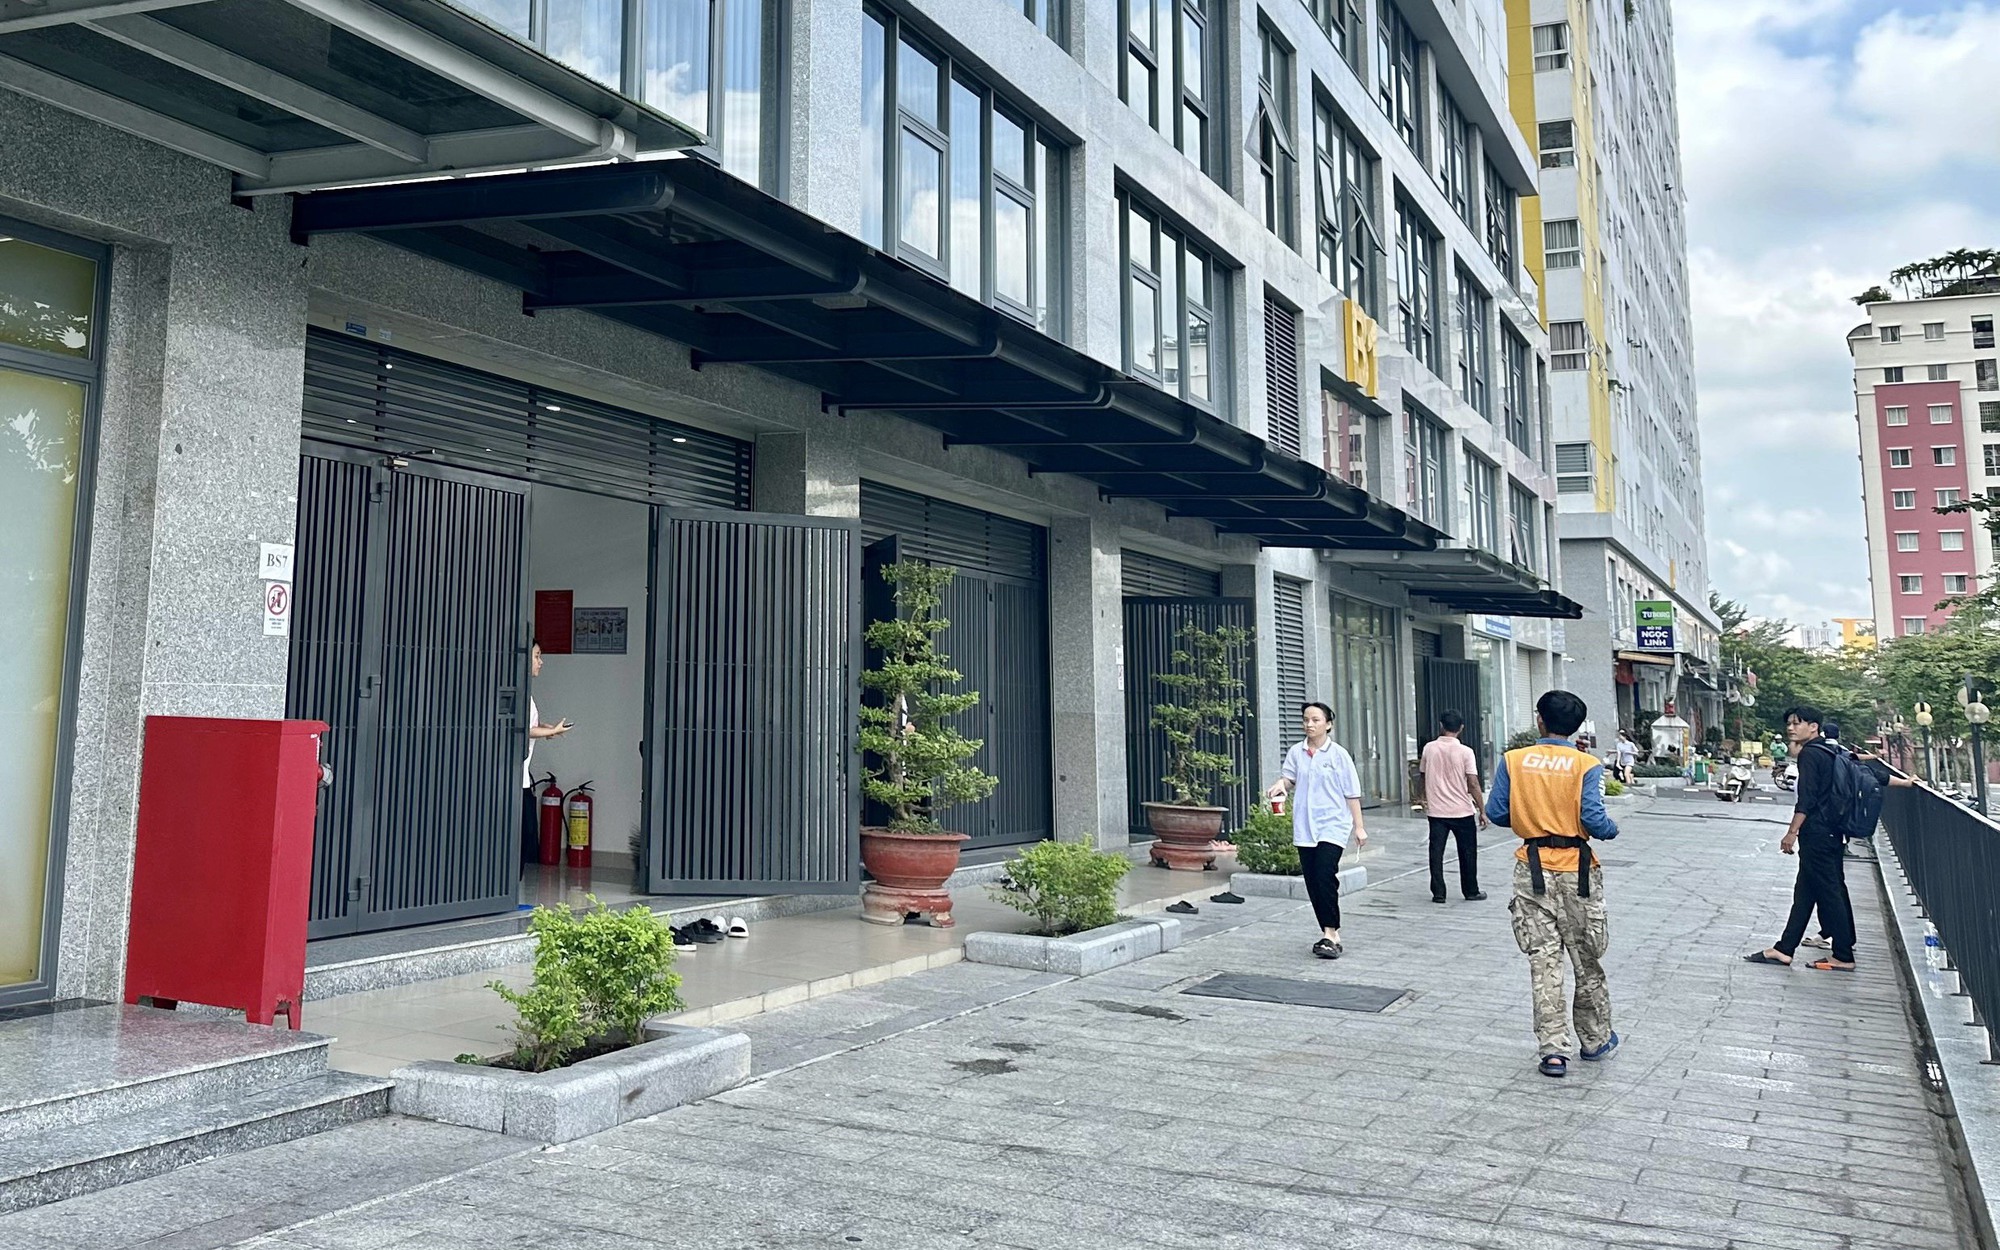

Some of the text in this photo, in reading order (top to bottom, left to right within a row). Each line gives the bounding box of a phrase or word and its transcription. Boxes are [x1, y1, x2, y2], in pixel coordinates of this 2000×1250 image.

[266, 552, 288, 569] BS7
[1641, 631, 1668, 639] NGỌC
[1522, 752, 1575, 772] GHN
